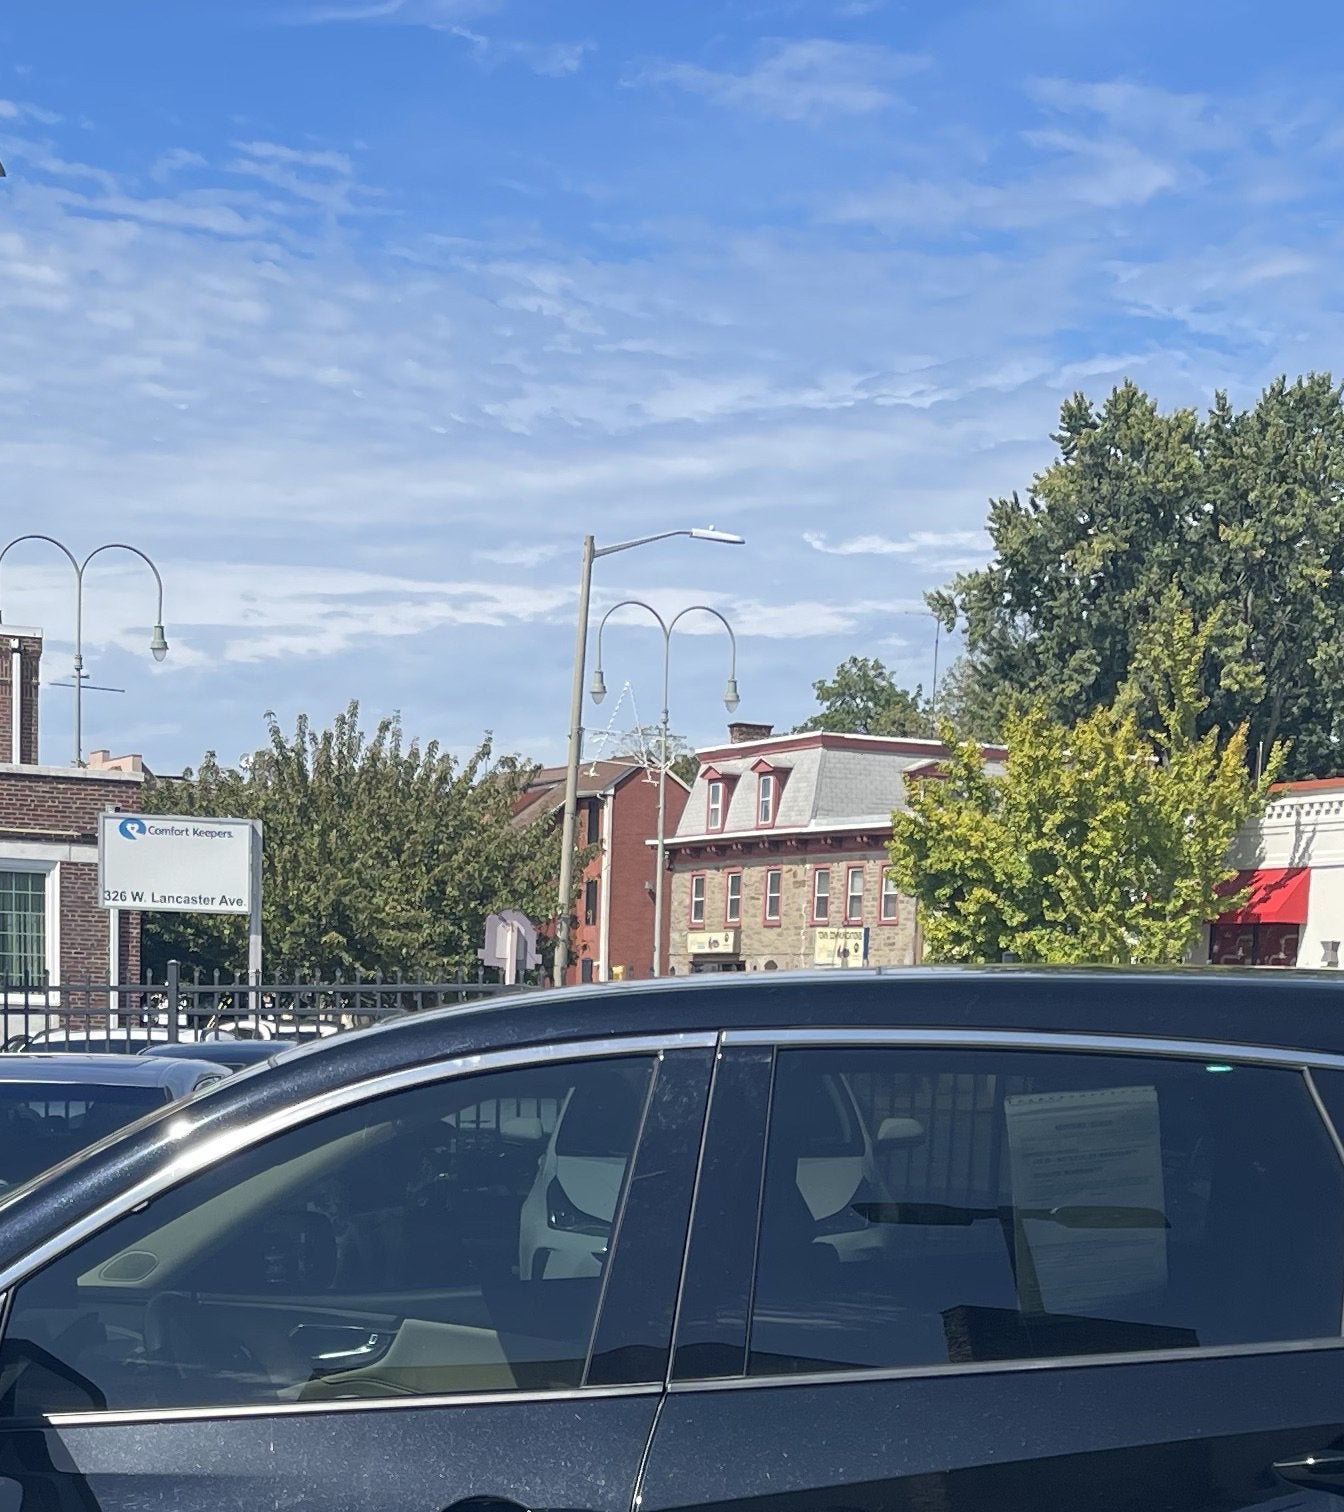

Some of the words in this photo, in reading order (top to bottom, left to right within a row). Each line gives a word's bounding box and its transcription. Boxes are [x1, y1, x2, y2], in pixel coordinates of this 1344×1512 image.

[148, 825, 189, 837] Comfort
[104, 890, 127, 902] 326
[131, 891, 146, 903] W.
[151, 892, 215, 907] Lancaster
[218, 895, 247, 907] Ave.
